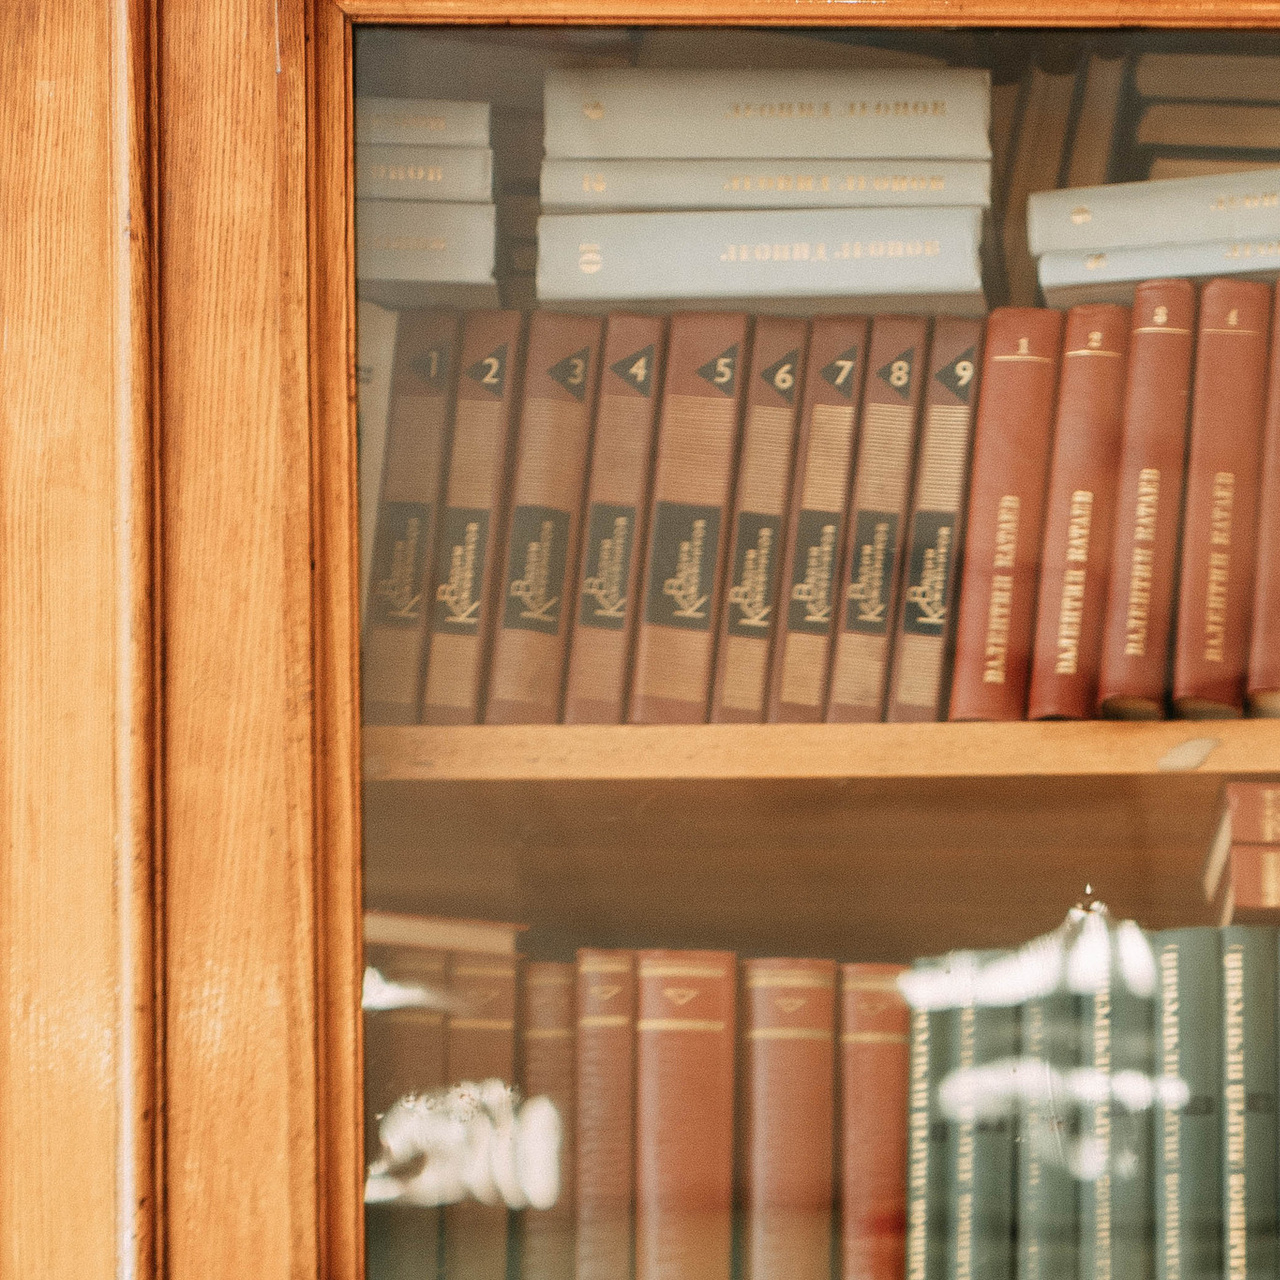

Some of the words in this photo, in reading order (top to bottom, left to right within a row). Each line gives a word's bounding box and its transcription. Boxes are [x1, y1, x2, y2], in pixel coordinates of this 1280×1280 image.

[429, 350, 438, 378] 1
[482, 357, 500, 384] 2
[568, 359, 584, 385] 3
[629, 357, 647, 382] 4
[714, 357, 733, 383] 5
[774, 363, 794, 389] 6
[834, 360, 854, 385] 7
[890, 360, 909, 386] 8
[954, 360, 974, 386] 9
